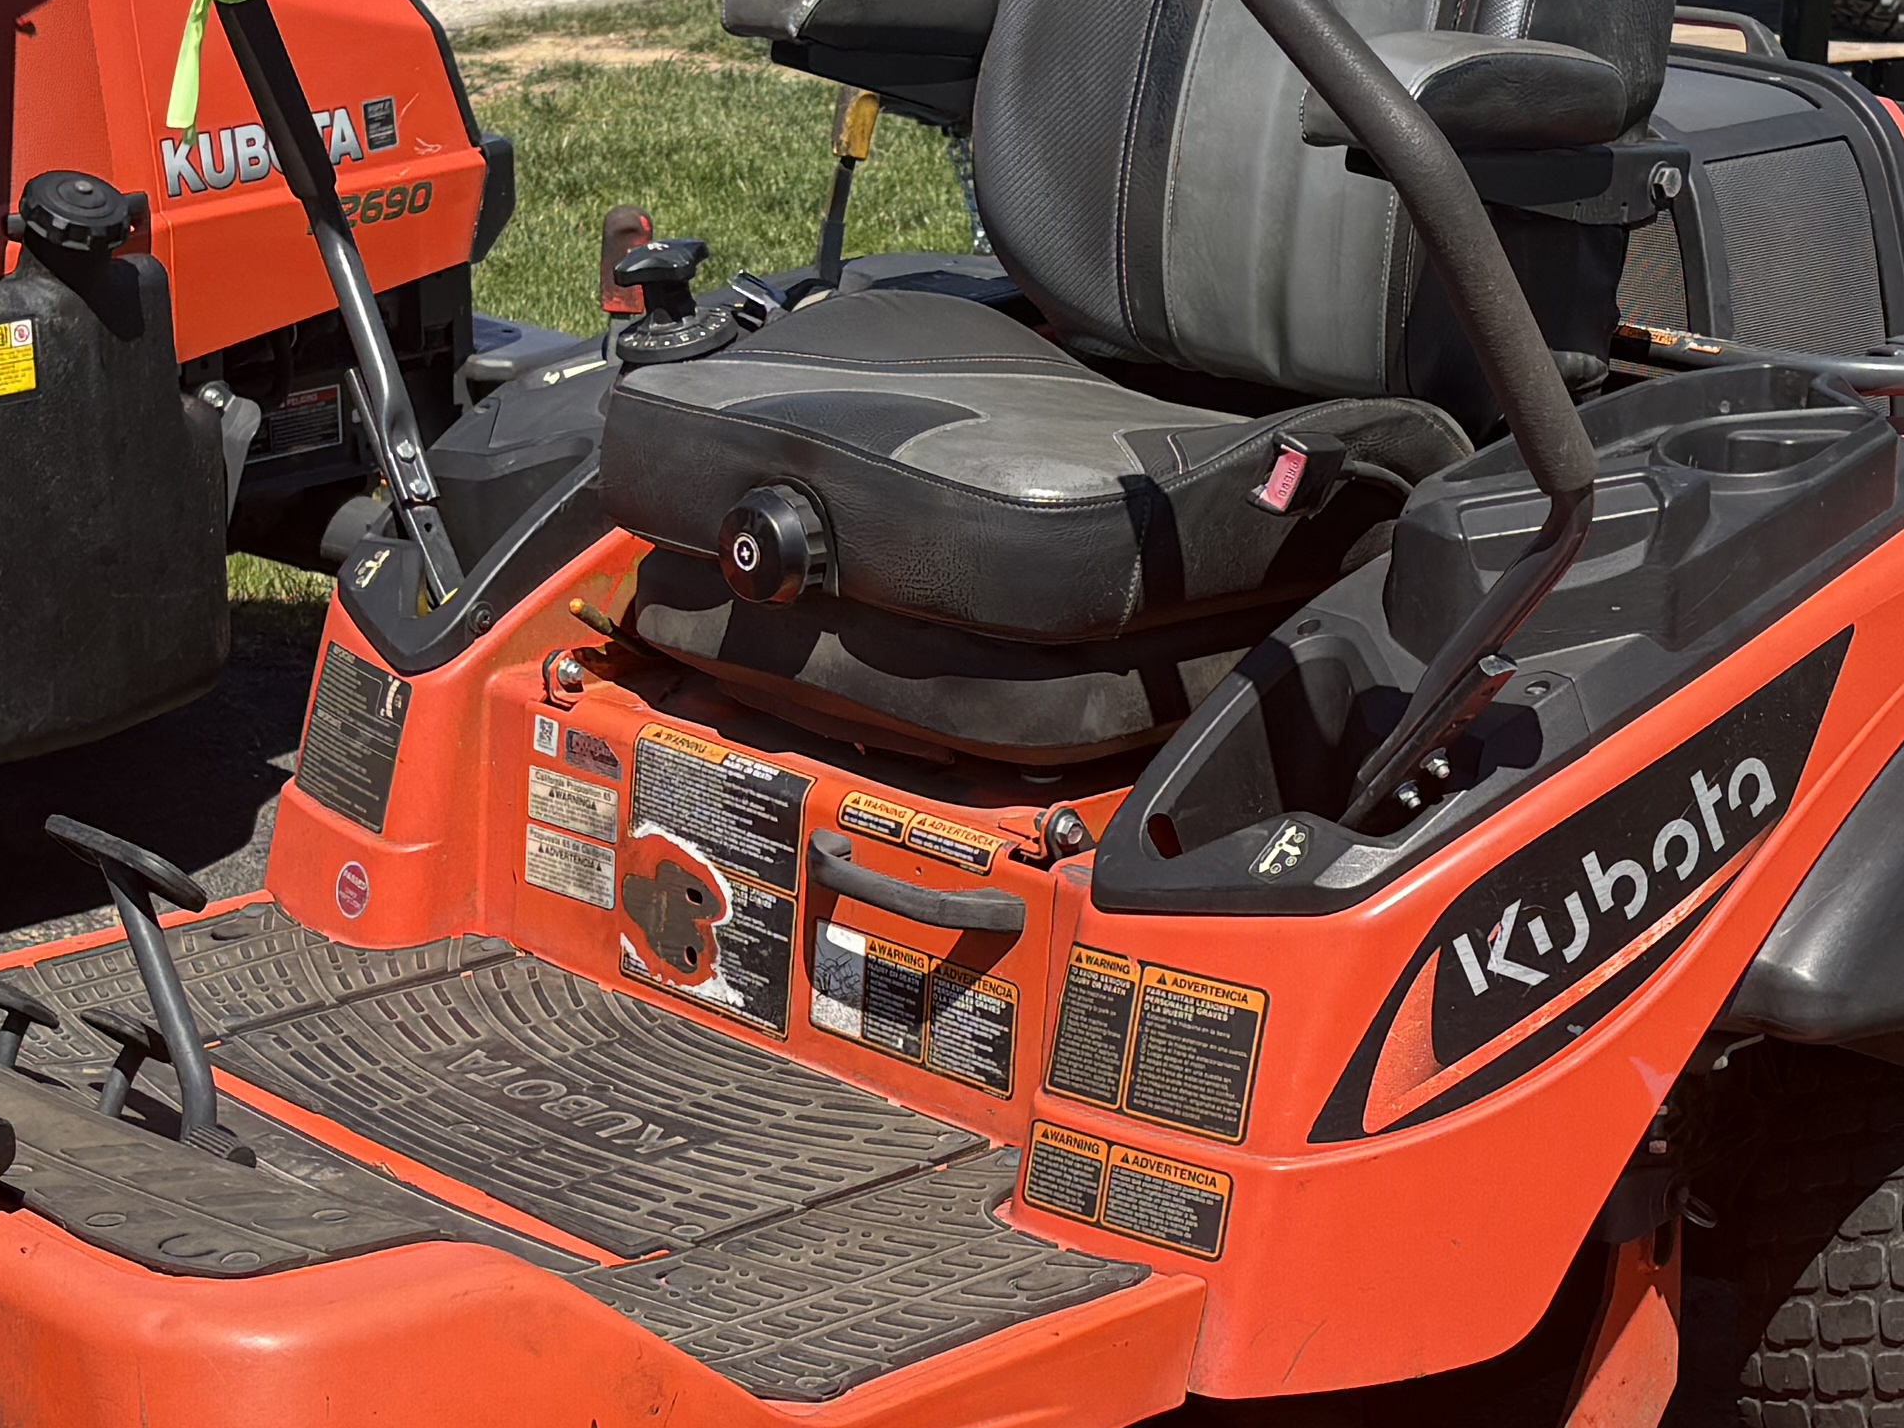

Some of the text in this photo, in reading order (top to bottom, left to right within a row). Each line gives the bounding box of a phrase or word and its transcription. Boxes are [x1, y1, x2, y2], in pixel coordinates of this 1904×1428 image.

[159, 105, 363, 197] KUBTA
[306, 180, 433, 236] 2690
[534, 771, 566, 788] California
[564, 780, 602, 800] Proposition
[554, 789, 593, 809] WARNING
[863, 798, 908, 819] WARNING
[928, 820, 994, 848] ADVERTENCIA
[543, 845, 597, 870] ADVERTENCIA
[1452, 758, 1777, 997] Kubota
[878, 944, 925, 970] WARNING
[1085, 954, 1131, 975] WARNING
[945, 967, 1014, 1000] ADVERTENCIA
[1146, 987, 1168, 999] PARA
[1168, 992, 1194, 1006] EVITAR
[1171, 976, 1250, 1005] ADVERTENCIA
[447, 1049, 688, 1154] KUBOTA
[1049, 1131, 1100, 1155] WARNING
[1131, 1155, 1218, 1189] ADVERTENCIA
